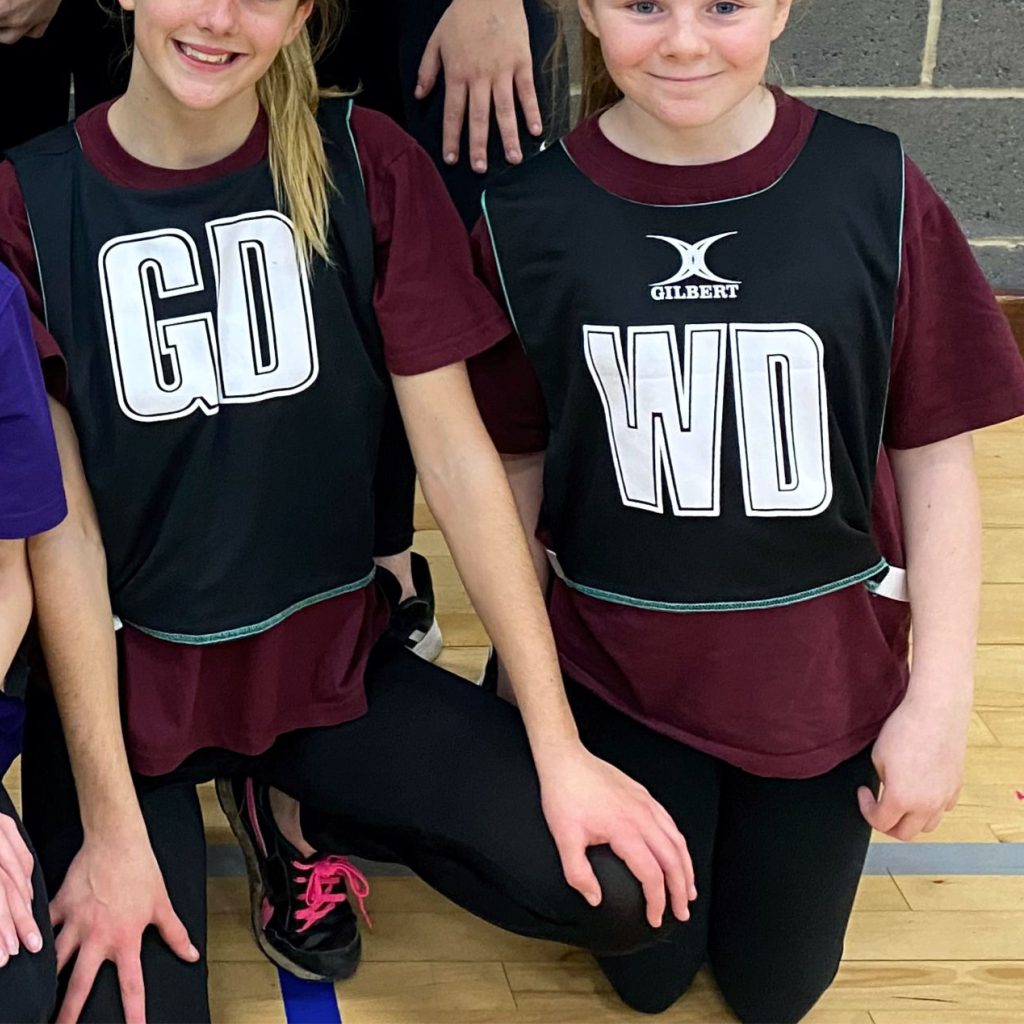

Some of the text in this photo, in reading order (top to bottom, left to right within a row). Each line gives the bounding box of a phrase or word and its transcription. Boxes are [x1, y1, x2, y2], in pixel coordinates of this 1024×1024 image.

[98, 209, 320, 423] GD
[650, 284, 739, 301] GILBERT
[582, 322, 833, 517] WD
